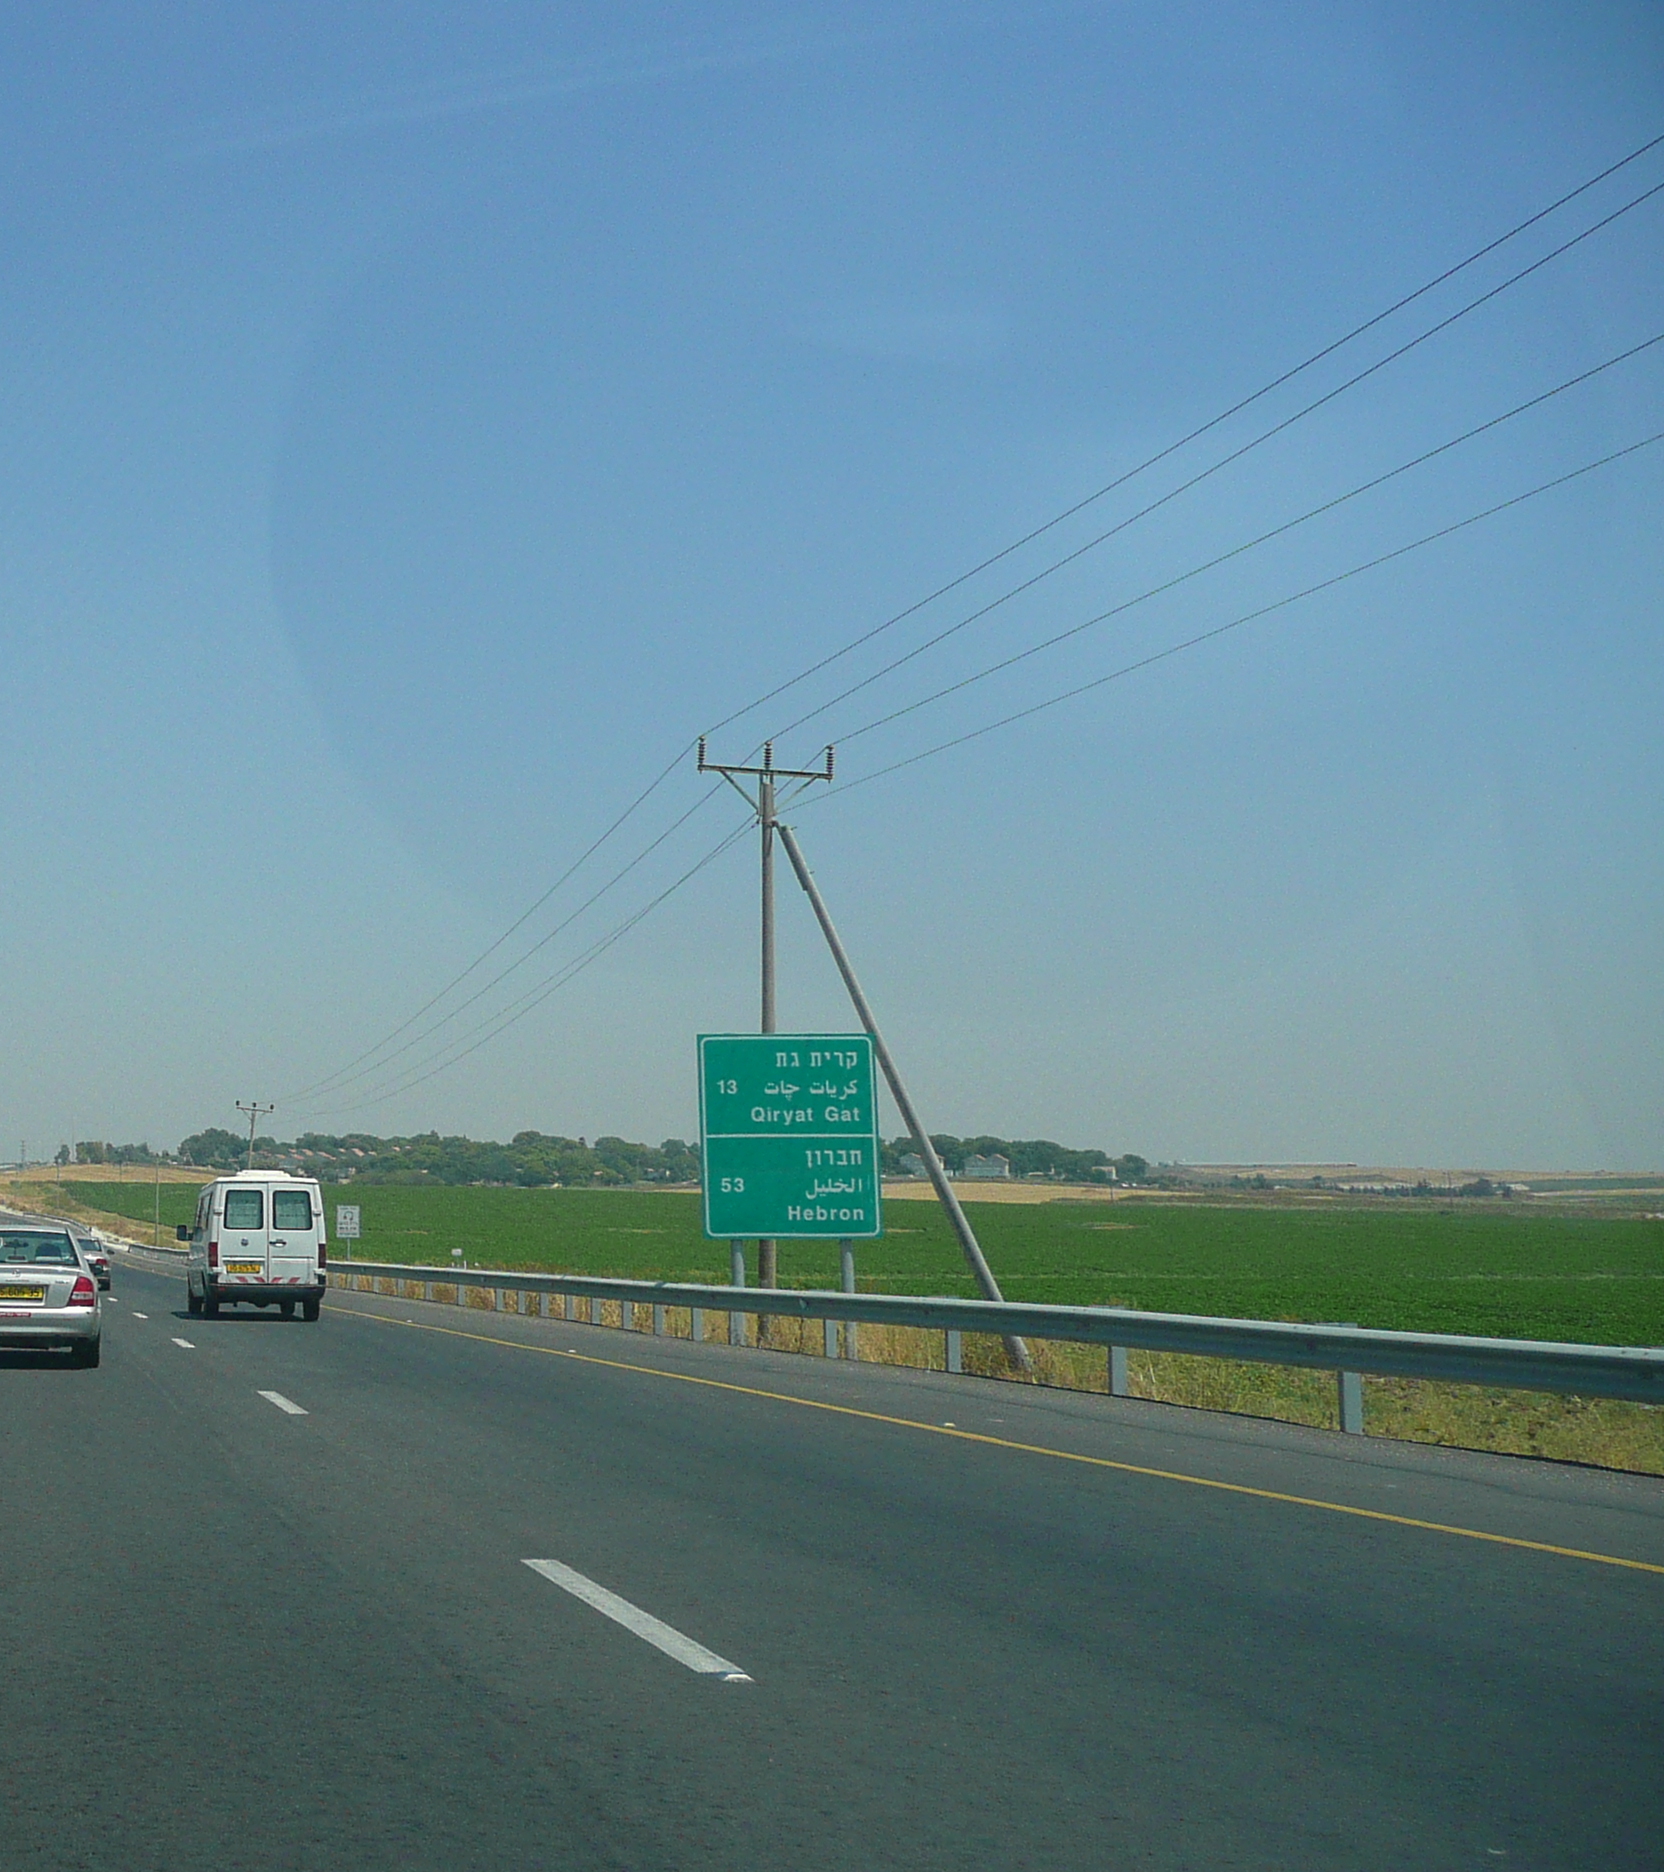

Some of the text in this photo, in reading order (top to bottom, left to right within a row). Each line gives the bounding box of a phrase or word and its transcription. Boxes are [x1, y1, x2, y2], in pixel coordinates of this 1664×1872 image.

[776, 1052, 858, 1069] קרית גת
[717, 1080, 738, 1095] 13
[809, 1079, 858, 1099] كريات
[751, 1106, 860, 1125] Qiryat Gat
[805, 1150, 861, 1168] חברון
[721, 1178, 745, 1192] 53
[805, 1178, 862, 1199] الخليل
[788, 1206, 864, 1221] Hebron
